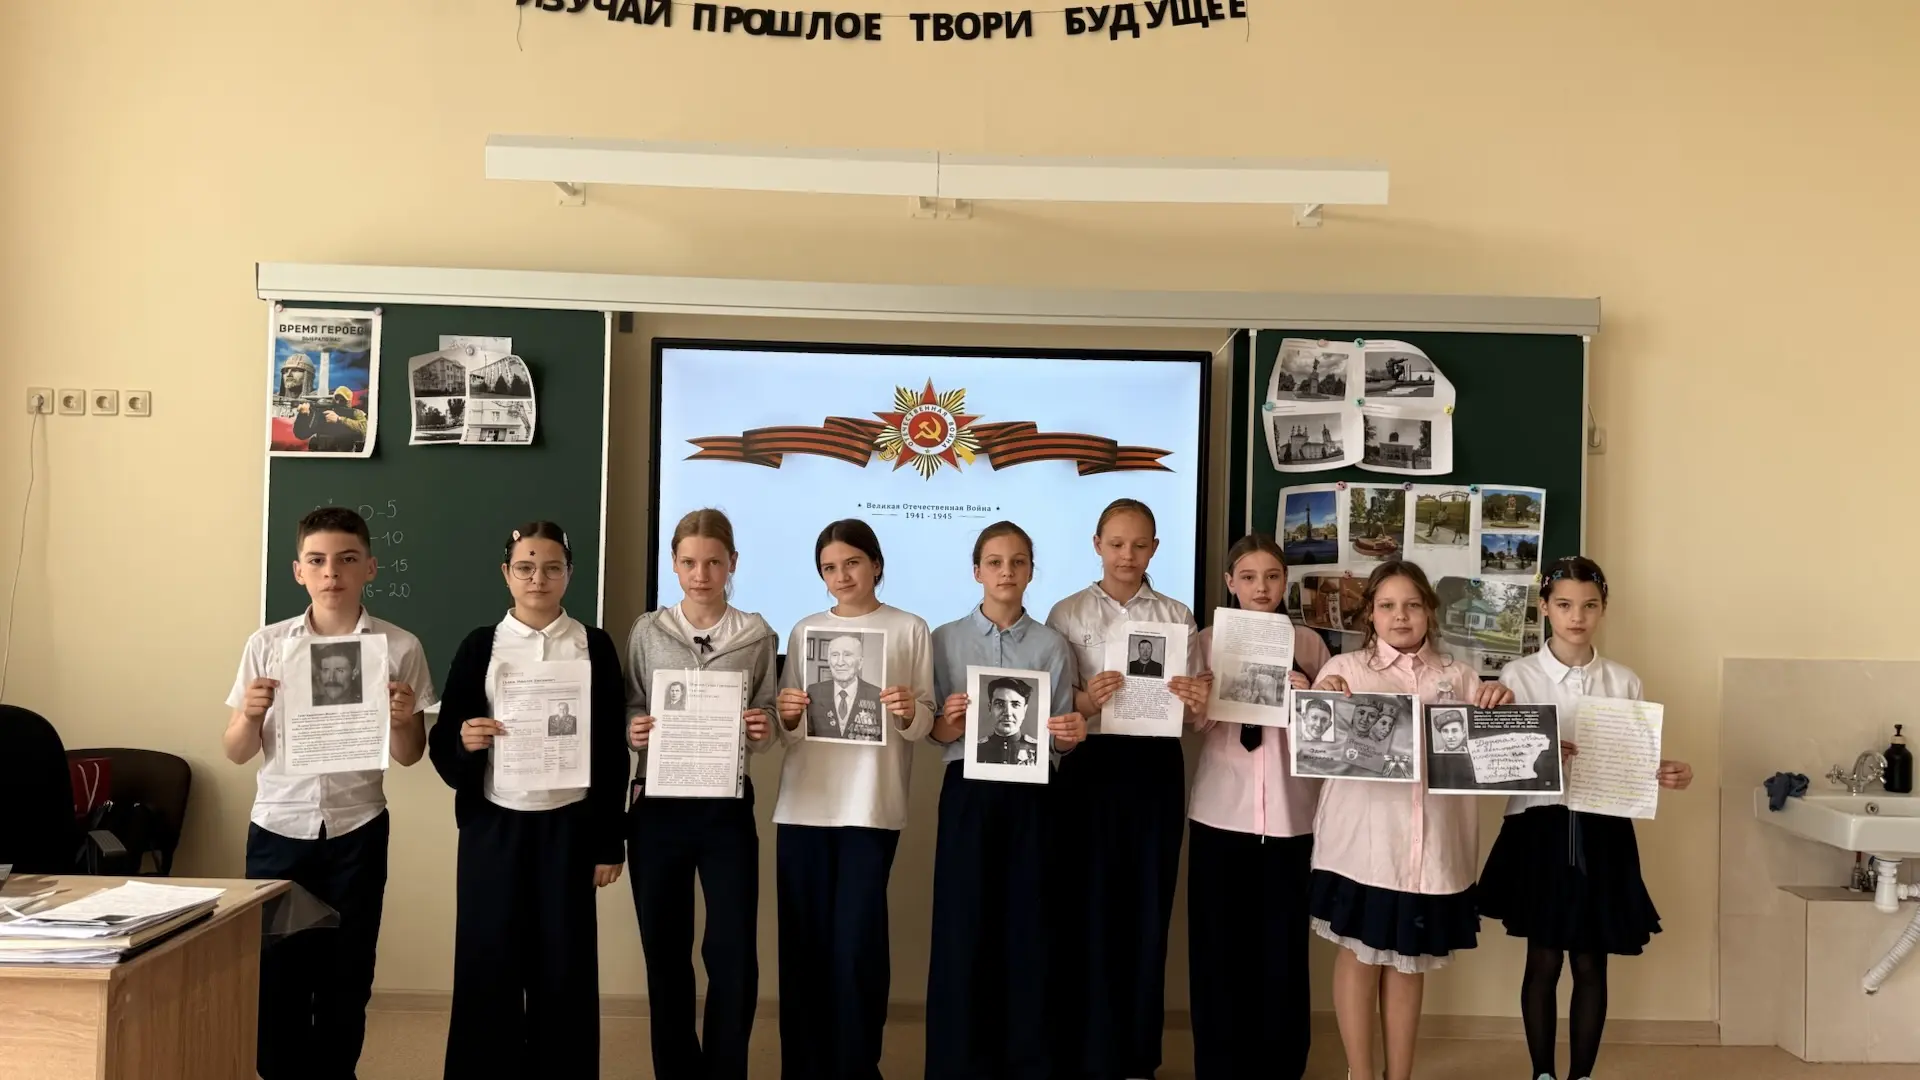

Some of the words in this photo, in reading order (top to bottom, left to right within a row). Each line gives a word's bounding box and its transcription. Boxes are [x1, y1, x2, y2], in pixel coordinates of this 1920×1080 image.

[693, 3, 881, 41] ПРОШЛОЕ
[910, 10, 1032, 42] ТВОРИ
[1065, 0, 1247, 41] БУДУЩЕЕ
[279, 324, 318, 334] ВРЕМЯ
[321, 325, 365, 335] ГЕРОЕВ
[902, 405, 948, 447] ОТЕЧЕСТВЕННАЯ
[941, 421, 956, 449] ВОЙНА
[866, 502, 900, 510] Великая
[903, 503, 964, 511] Отечественная
[966, 504, 992, 512] Война
[933, 512, 953, 520] 1945
